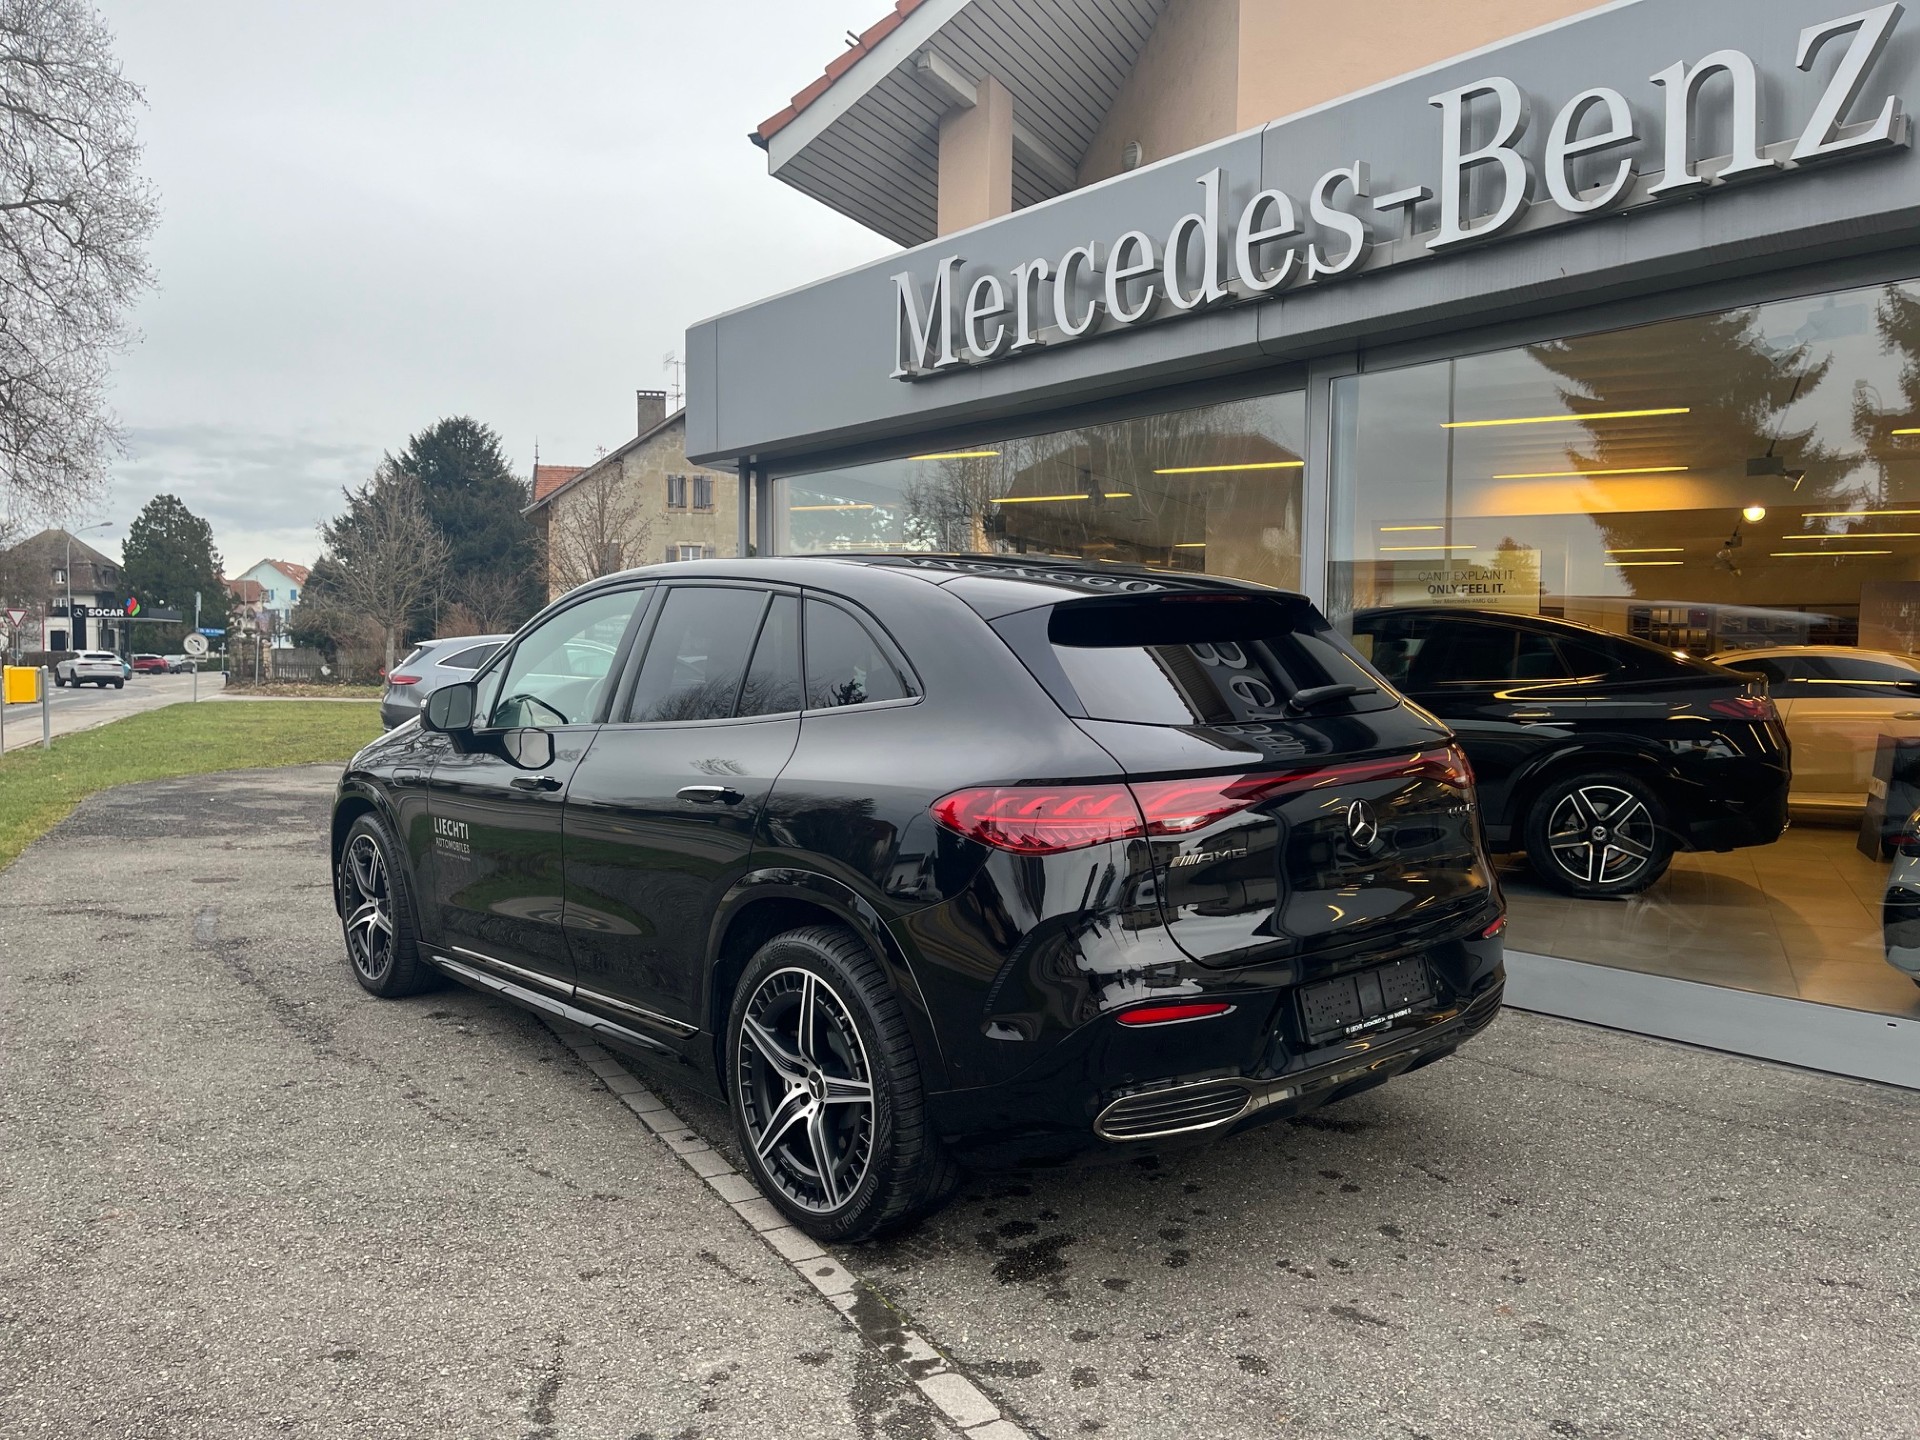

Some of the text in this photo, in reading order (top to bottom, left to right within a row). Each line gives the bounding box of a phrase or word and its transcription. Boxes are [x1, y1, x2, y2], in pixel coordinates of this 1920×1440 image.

[889, 1, 1905, 381] Mercedes-Benz
[1418, 570, 1516, 582] CAN'T EXPLAIN IT.
[1427, 583, 1506, 595] ONLY FEEL IT.
[88, 608, 124, 617] SOCAR
[434, 817, 469, 840] LIECHTI
[1193, 848, 1248, 865] AMG
